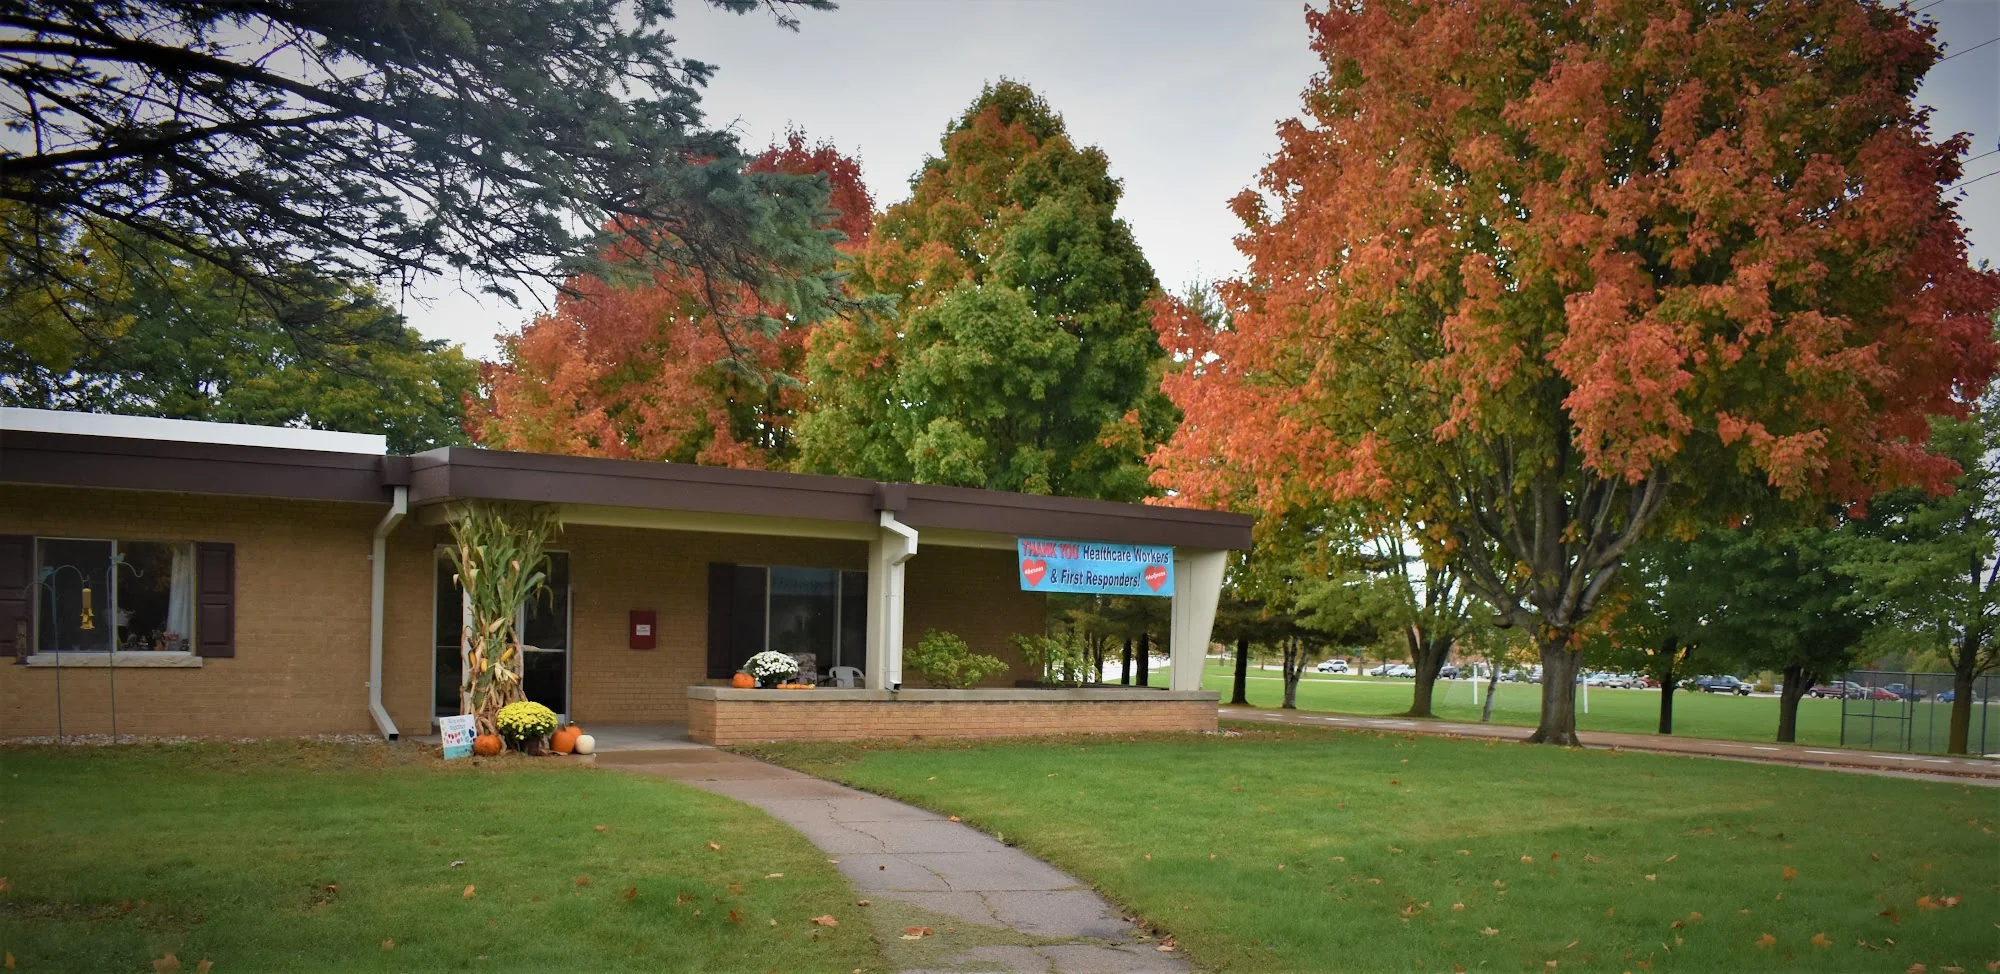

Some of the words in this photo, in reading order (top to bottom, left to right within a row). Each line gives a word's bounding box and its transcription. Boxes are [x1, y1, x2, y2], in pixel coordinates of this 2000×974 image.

[1022, 540, 1057, 558] THANK
[1058, 543, 1080, 560] YOU
[1083, 545, 1132, 562] Healthcare
[1133, 547, 1169, 563] Workers
[1050, 568, 1057, 583] &
[1061, 569, 1083, 585] First
[1086, 570, 1141, 589] Responders!
